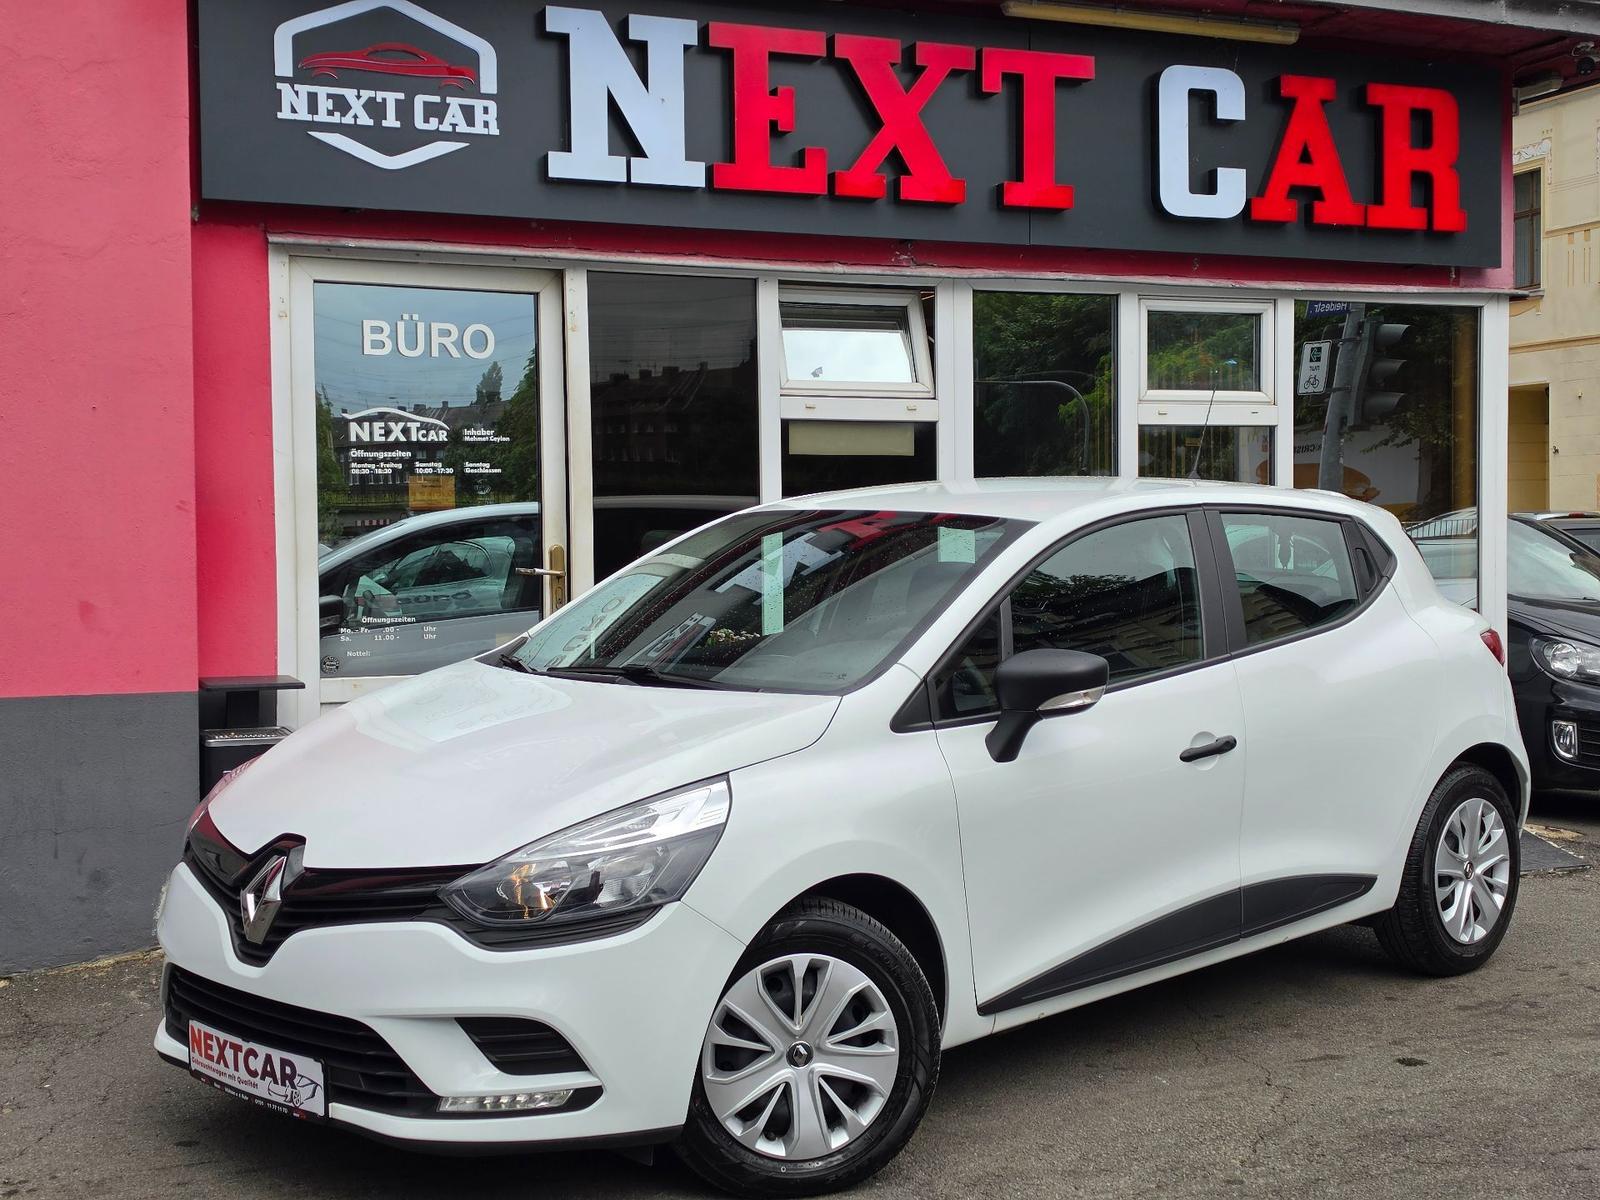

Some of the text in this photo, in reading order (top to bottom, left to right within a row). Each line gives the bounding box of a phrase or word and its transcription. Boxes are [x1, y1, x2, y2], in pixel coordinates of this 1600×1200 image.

[276, 82, 500, 136] NEXT CAR
[545, 5, 1468, 233] NEXT CAR
[361, 313, 496, 360] BÜRO
[464, 428, 495, 436] Inhaber
[350, 448, 412, 459] Öffnungszeiten
[464, 461, 490, 469] Sonntag
[190, 1024, 298, 1089] NEXTCAR
[228, 1073, 236, 1081] mit
